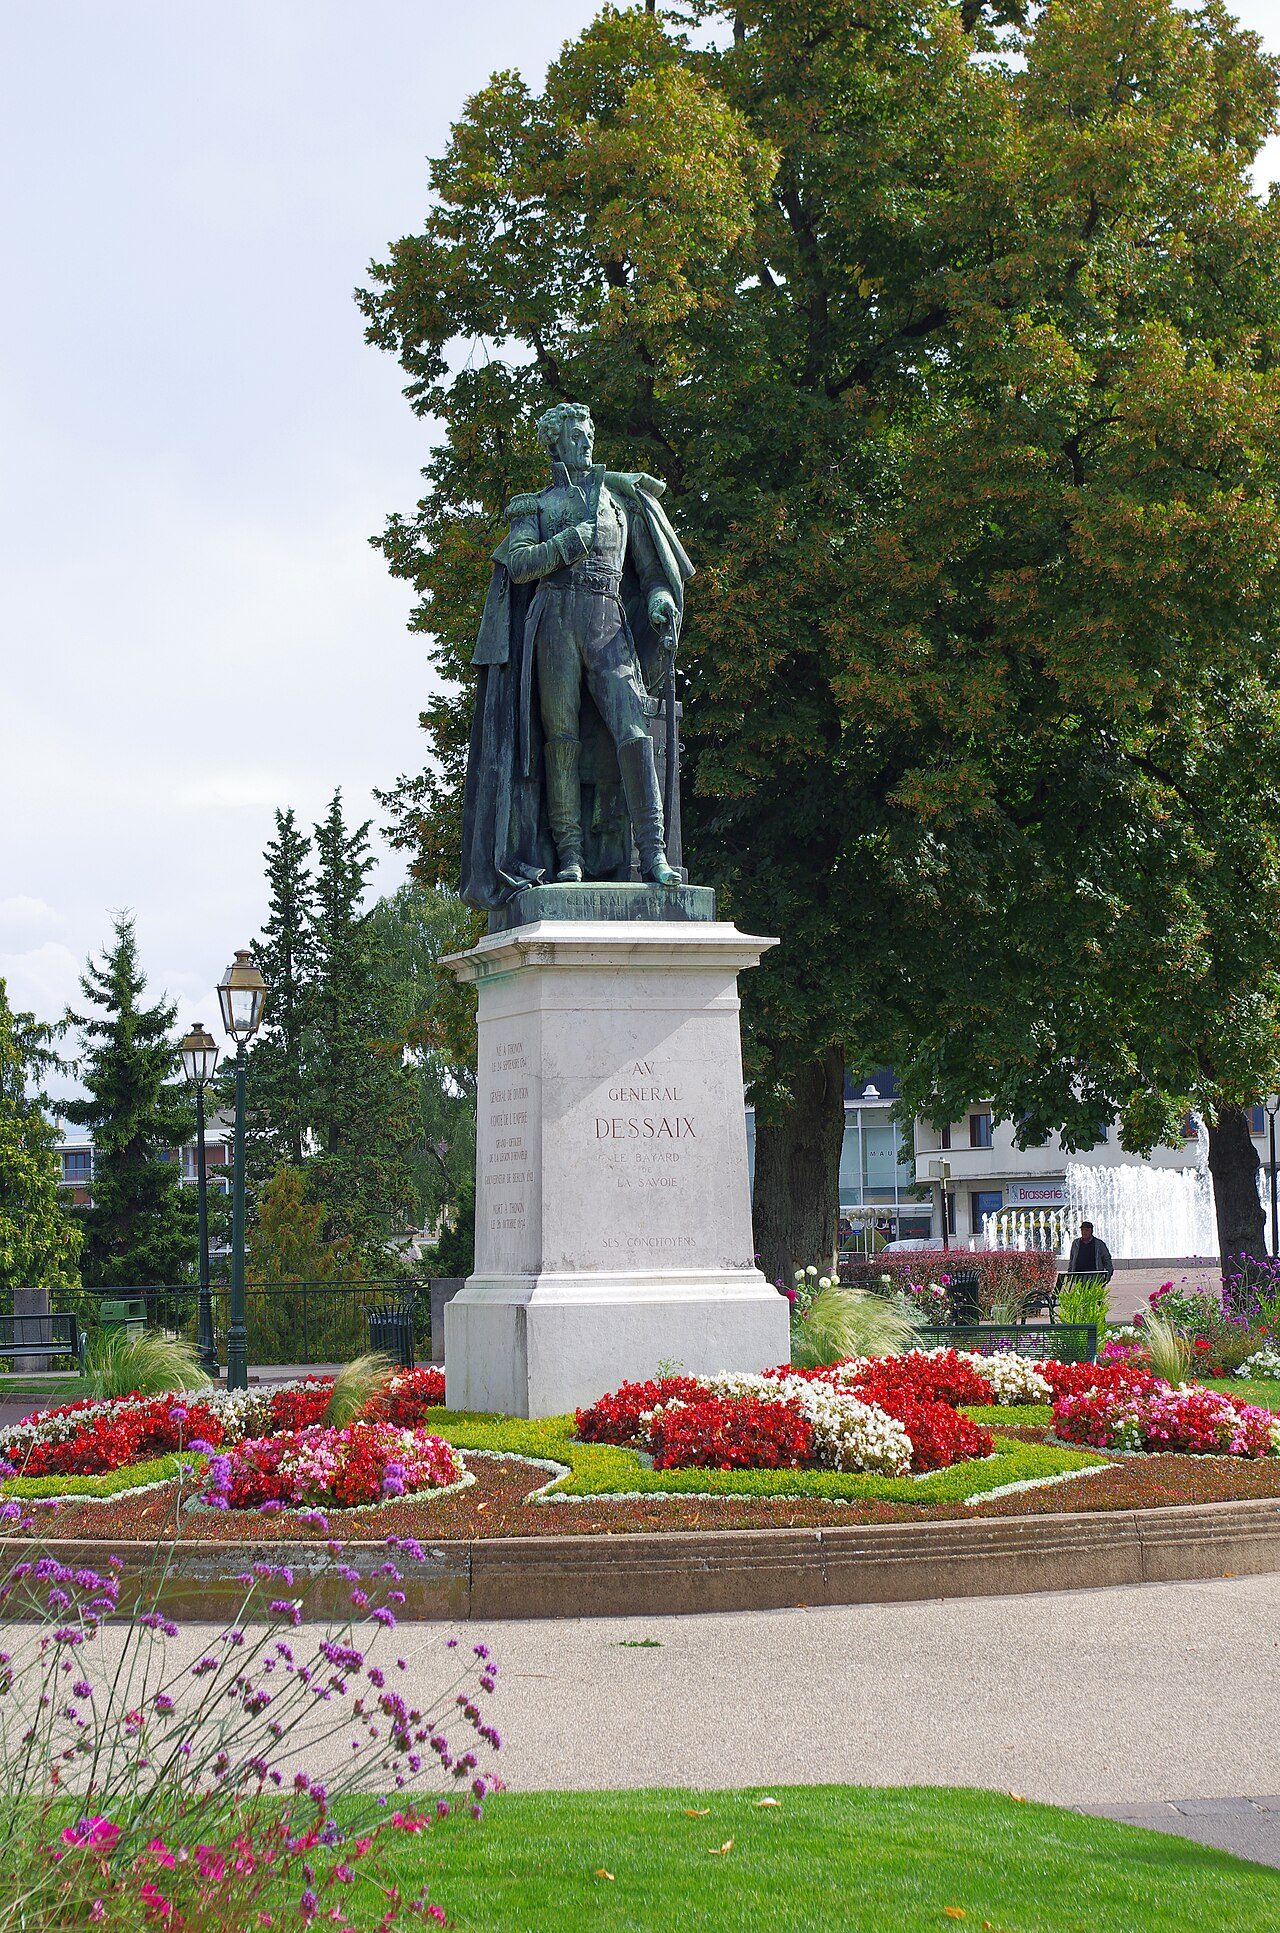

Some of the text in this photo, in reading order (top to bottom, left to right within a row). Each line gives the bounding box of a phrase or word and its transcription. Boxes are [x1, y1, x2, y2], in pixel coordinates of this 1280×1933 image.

[608, 1087, 683, 1101] GENERAL
[595, 1117, 696, 1139] DESSAIX
[614, 1152, 680, 1163] LE BAYARD
[617, 1177, 678, 1188] LA SAVOIE
[1019, 1188, 1063, 1200] Brasserie
[602, 1238, 620, 1248] SES
